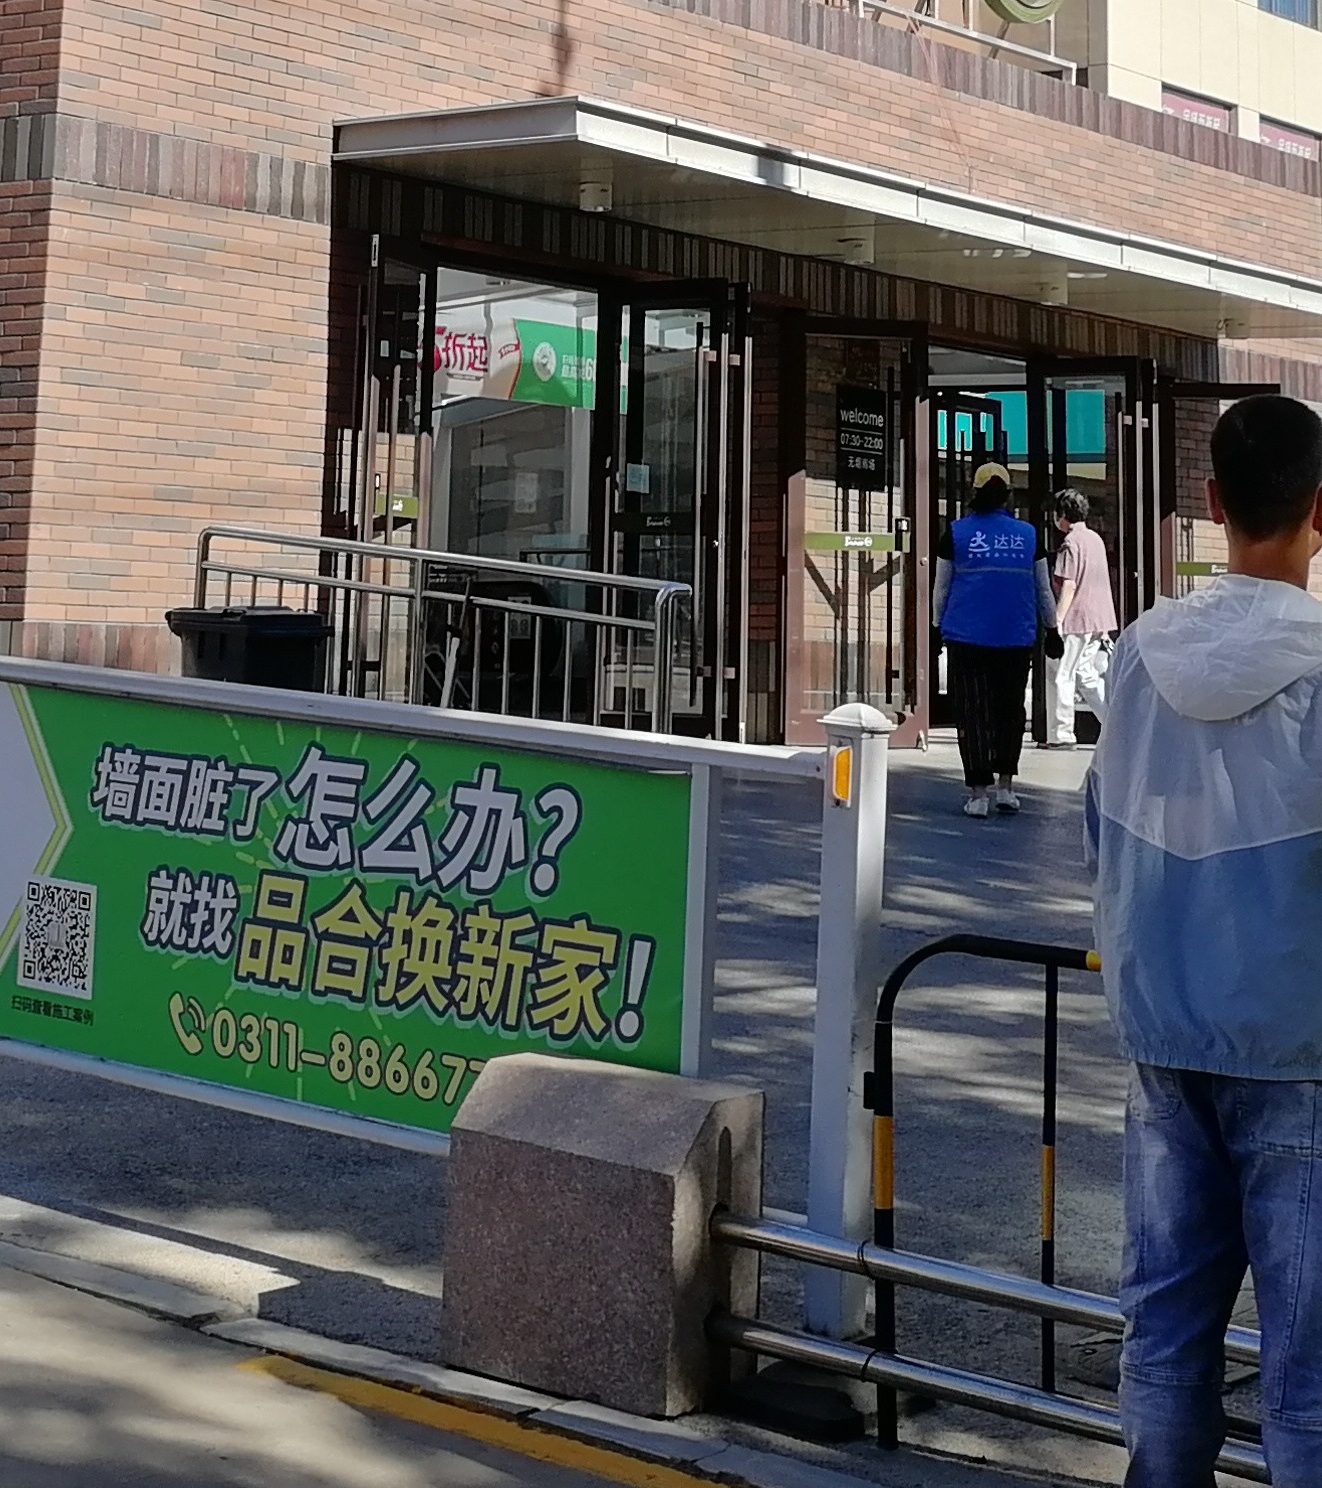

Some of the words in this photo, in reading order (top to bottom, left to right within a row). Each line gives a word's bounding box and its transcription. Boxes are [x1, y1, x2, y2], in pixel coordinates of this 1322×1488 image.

[840, 407, 884, 427] welcome
[840, 432, 884, 451] 07:30-22:00
[993, 533, 1025, 550] 达达
[92, 743, 581, 901] 墙面脏了怎么办？
[143, 869, 656, 1044] 就找品合换新家！
[11, 995, 95, 1026] 扫码查看施工案例
